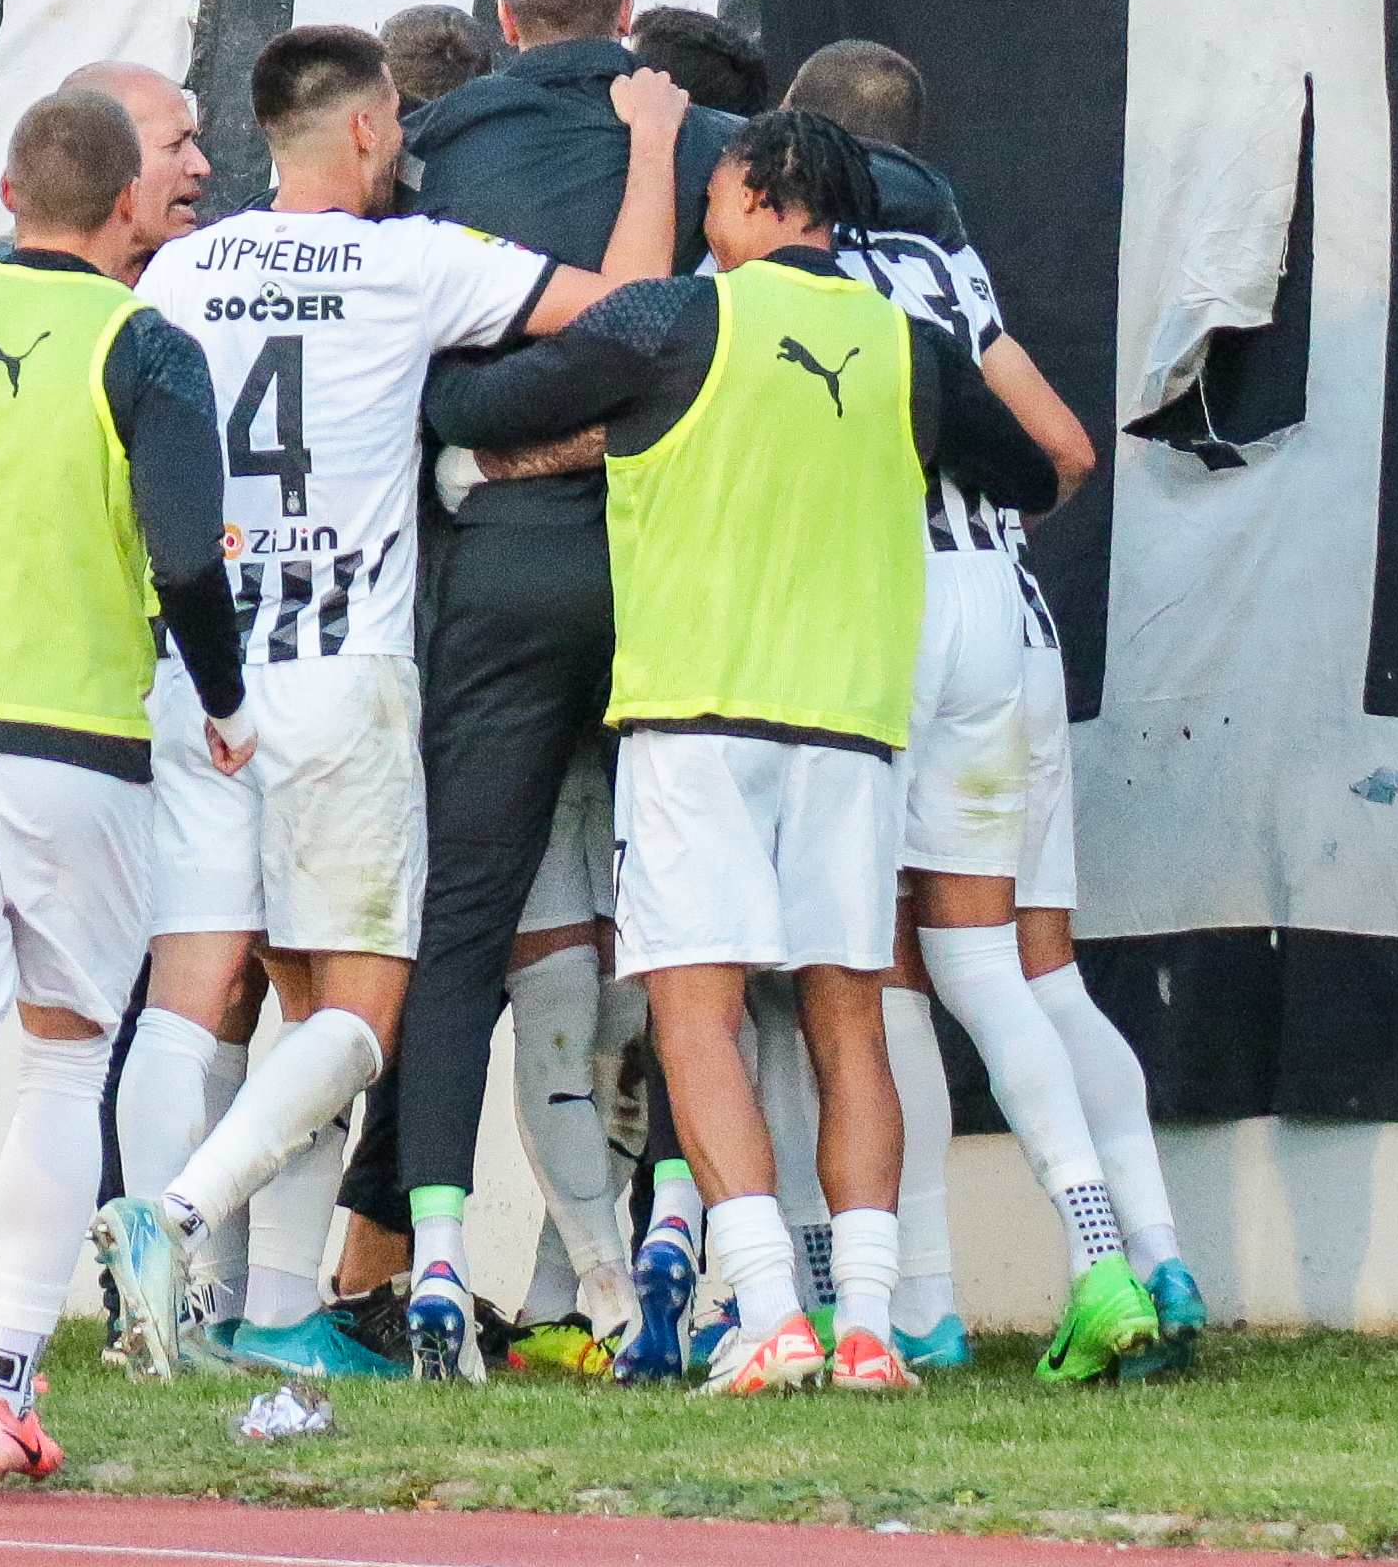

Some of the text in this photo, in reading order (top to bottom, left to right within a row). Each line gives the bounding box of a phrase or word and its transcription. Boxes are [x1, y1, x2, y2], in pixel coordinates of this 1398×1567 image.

[195, 235, 363, 273] ЈУРЧЕВИЋ
[203, 293, 346, 322] SOCCER
[226, 334, 313, 517] 4
